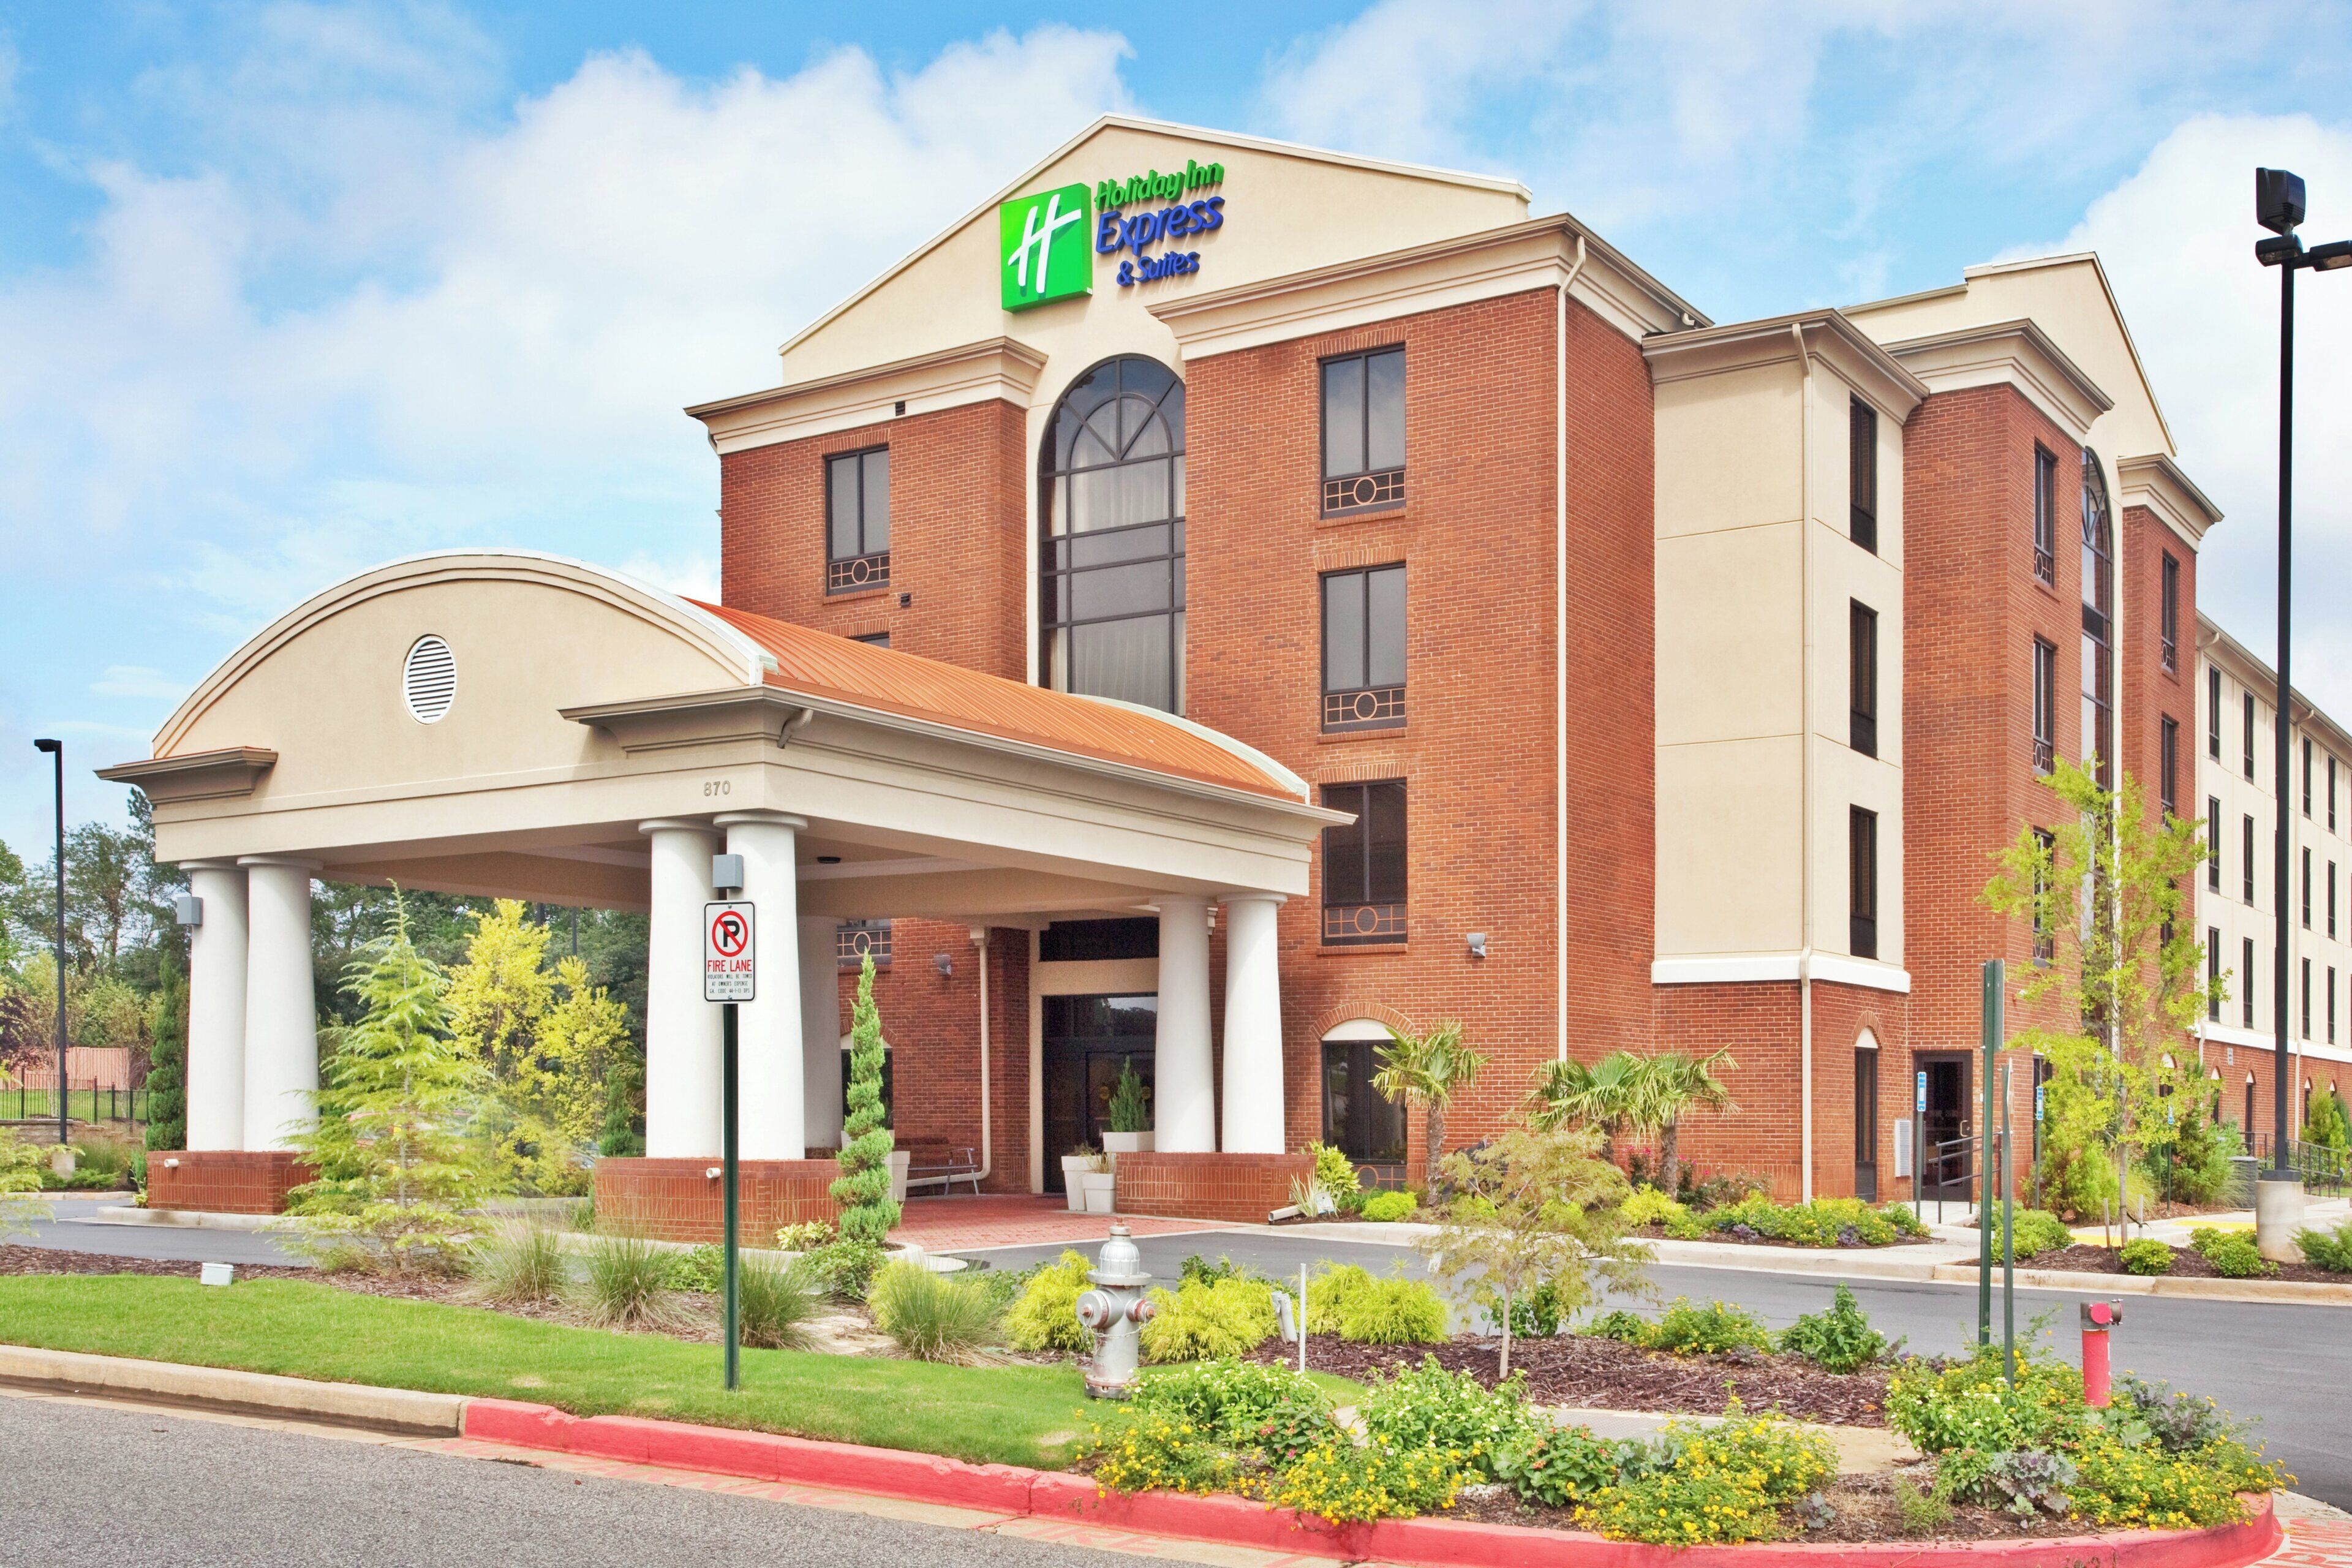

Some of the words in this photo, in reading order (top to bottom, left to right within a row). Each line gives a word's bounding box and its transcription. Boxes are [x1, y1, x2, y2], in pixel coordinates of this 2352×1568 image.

[1094, 170, 1186, 211] Holiday
[1185, 159, 1225, 190] Inn
[1008, 193, 1082, 293] H
[1095, 196, 1225, 257] Express
[1116, 260, 1134, 287] &
[1135, 251, 1200, 284] Suites
[703, 780, 731, 797] 870
[723, 921, 740, 947] P
[707, 960, 726, 972] FIRE
[730, 959, 752, 972] LANE
